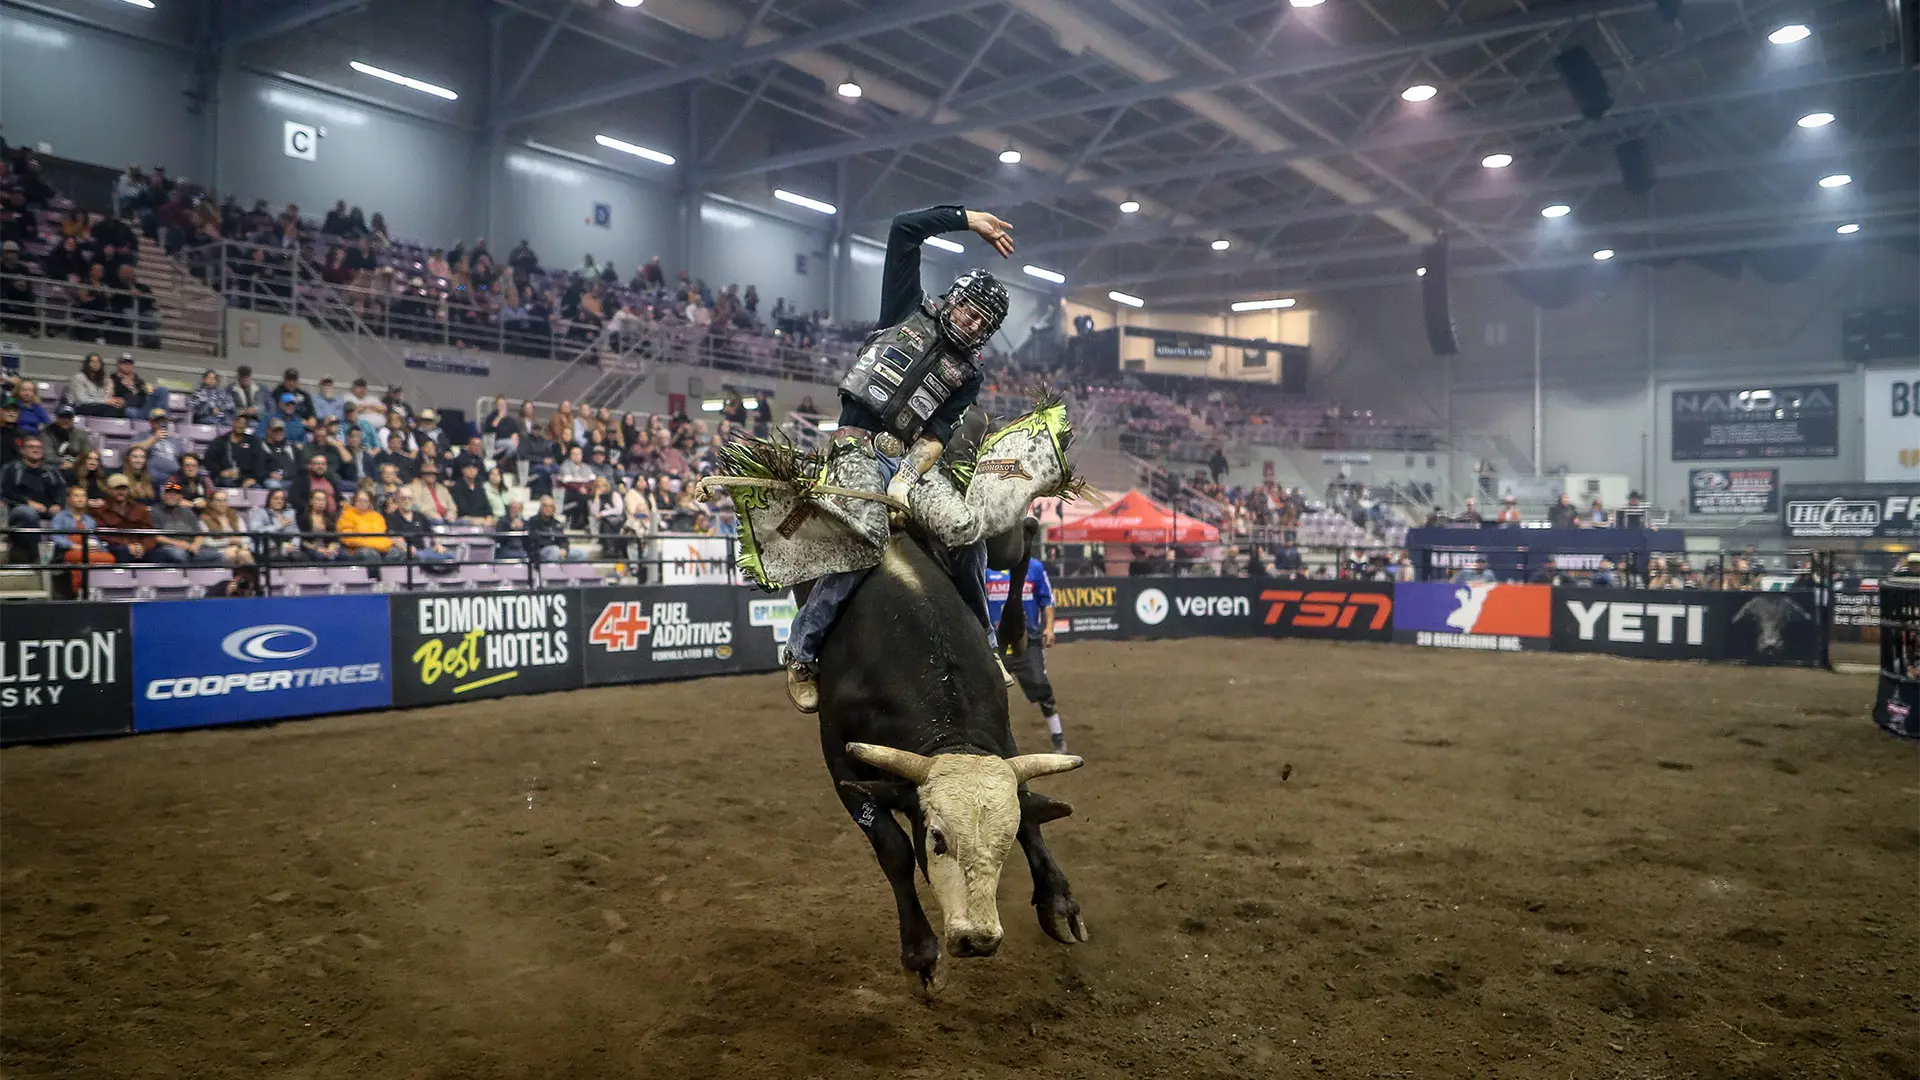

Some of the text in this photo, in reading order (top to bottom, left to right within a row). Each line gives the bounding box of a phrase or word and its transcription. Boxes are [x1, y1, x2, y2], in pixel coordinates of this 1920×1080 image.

[292, 130, 309, 153] C
[419, 593, 568, 635] EDMONTON'S
[652, 602, 690, 626] FUEL
[1176, 596, 1250, 616] veren
[1260, 589, 1393, 631] TSN
[652, 621, 733, 648] ADDITIVES
[1566, 600, 1706, 647] YETI
[411, 626, 569, 685] Best HOTELS
